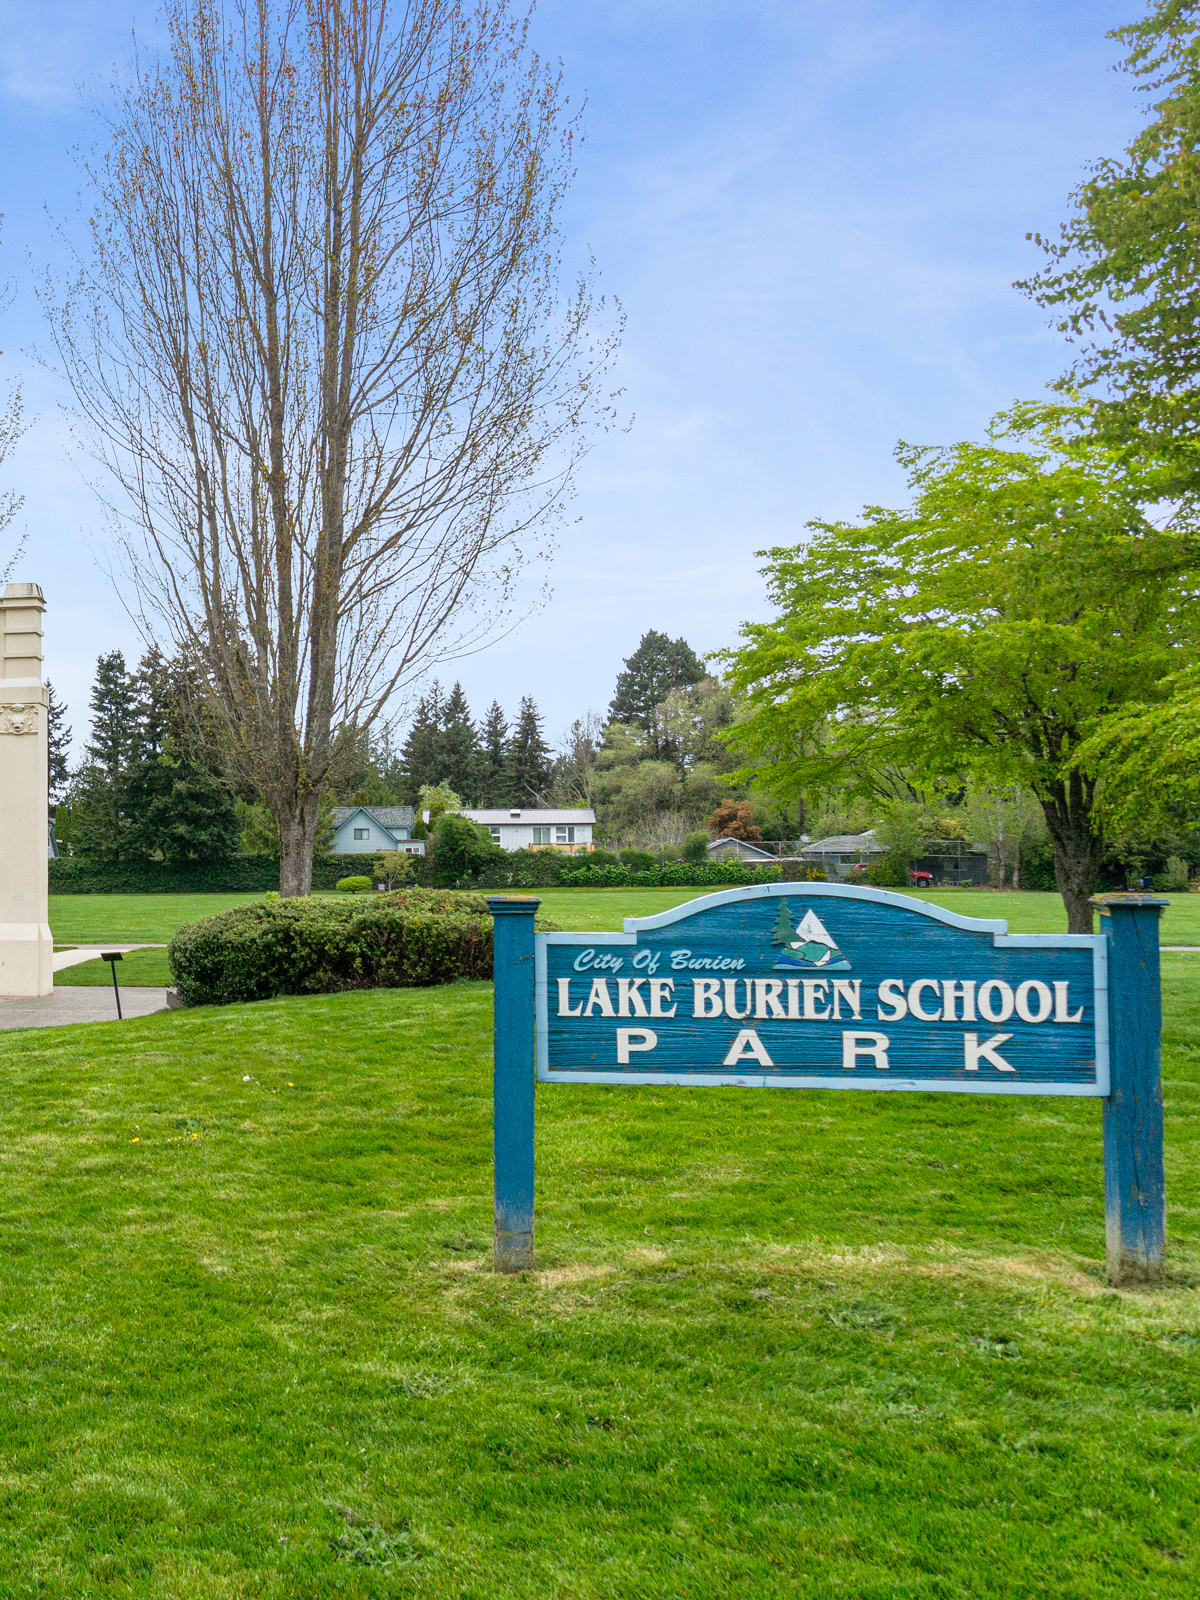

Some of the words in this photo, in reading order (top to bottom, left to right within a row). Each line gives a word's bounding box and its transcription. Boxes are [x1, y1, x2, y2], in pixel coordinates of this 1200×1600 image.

[573, 949, 624, 974] City
[632, 949, 661, 975] Of
[670, 949, 746, 971] Burien
[556, 977, 678, 1018] LAKE
[691, 978, 863, 1020] BURIEN
[877, 979, 1084, 1023] SCHOOL
[616, 1027, 1017, 1072] PARK
